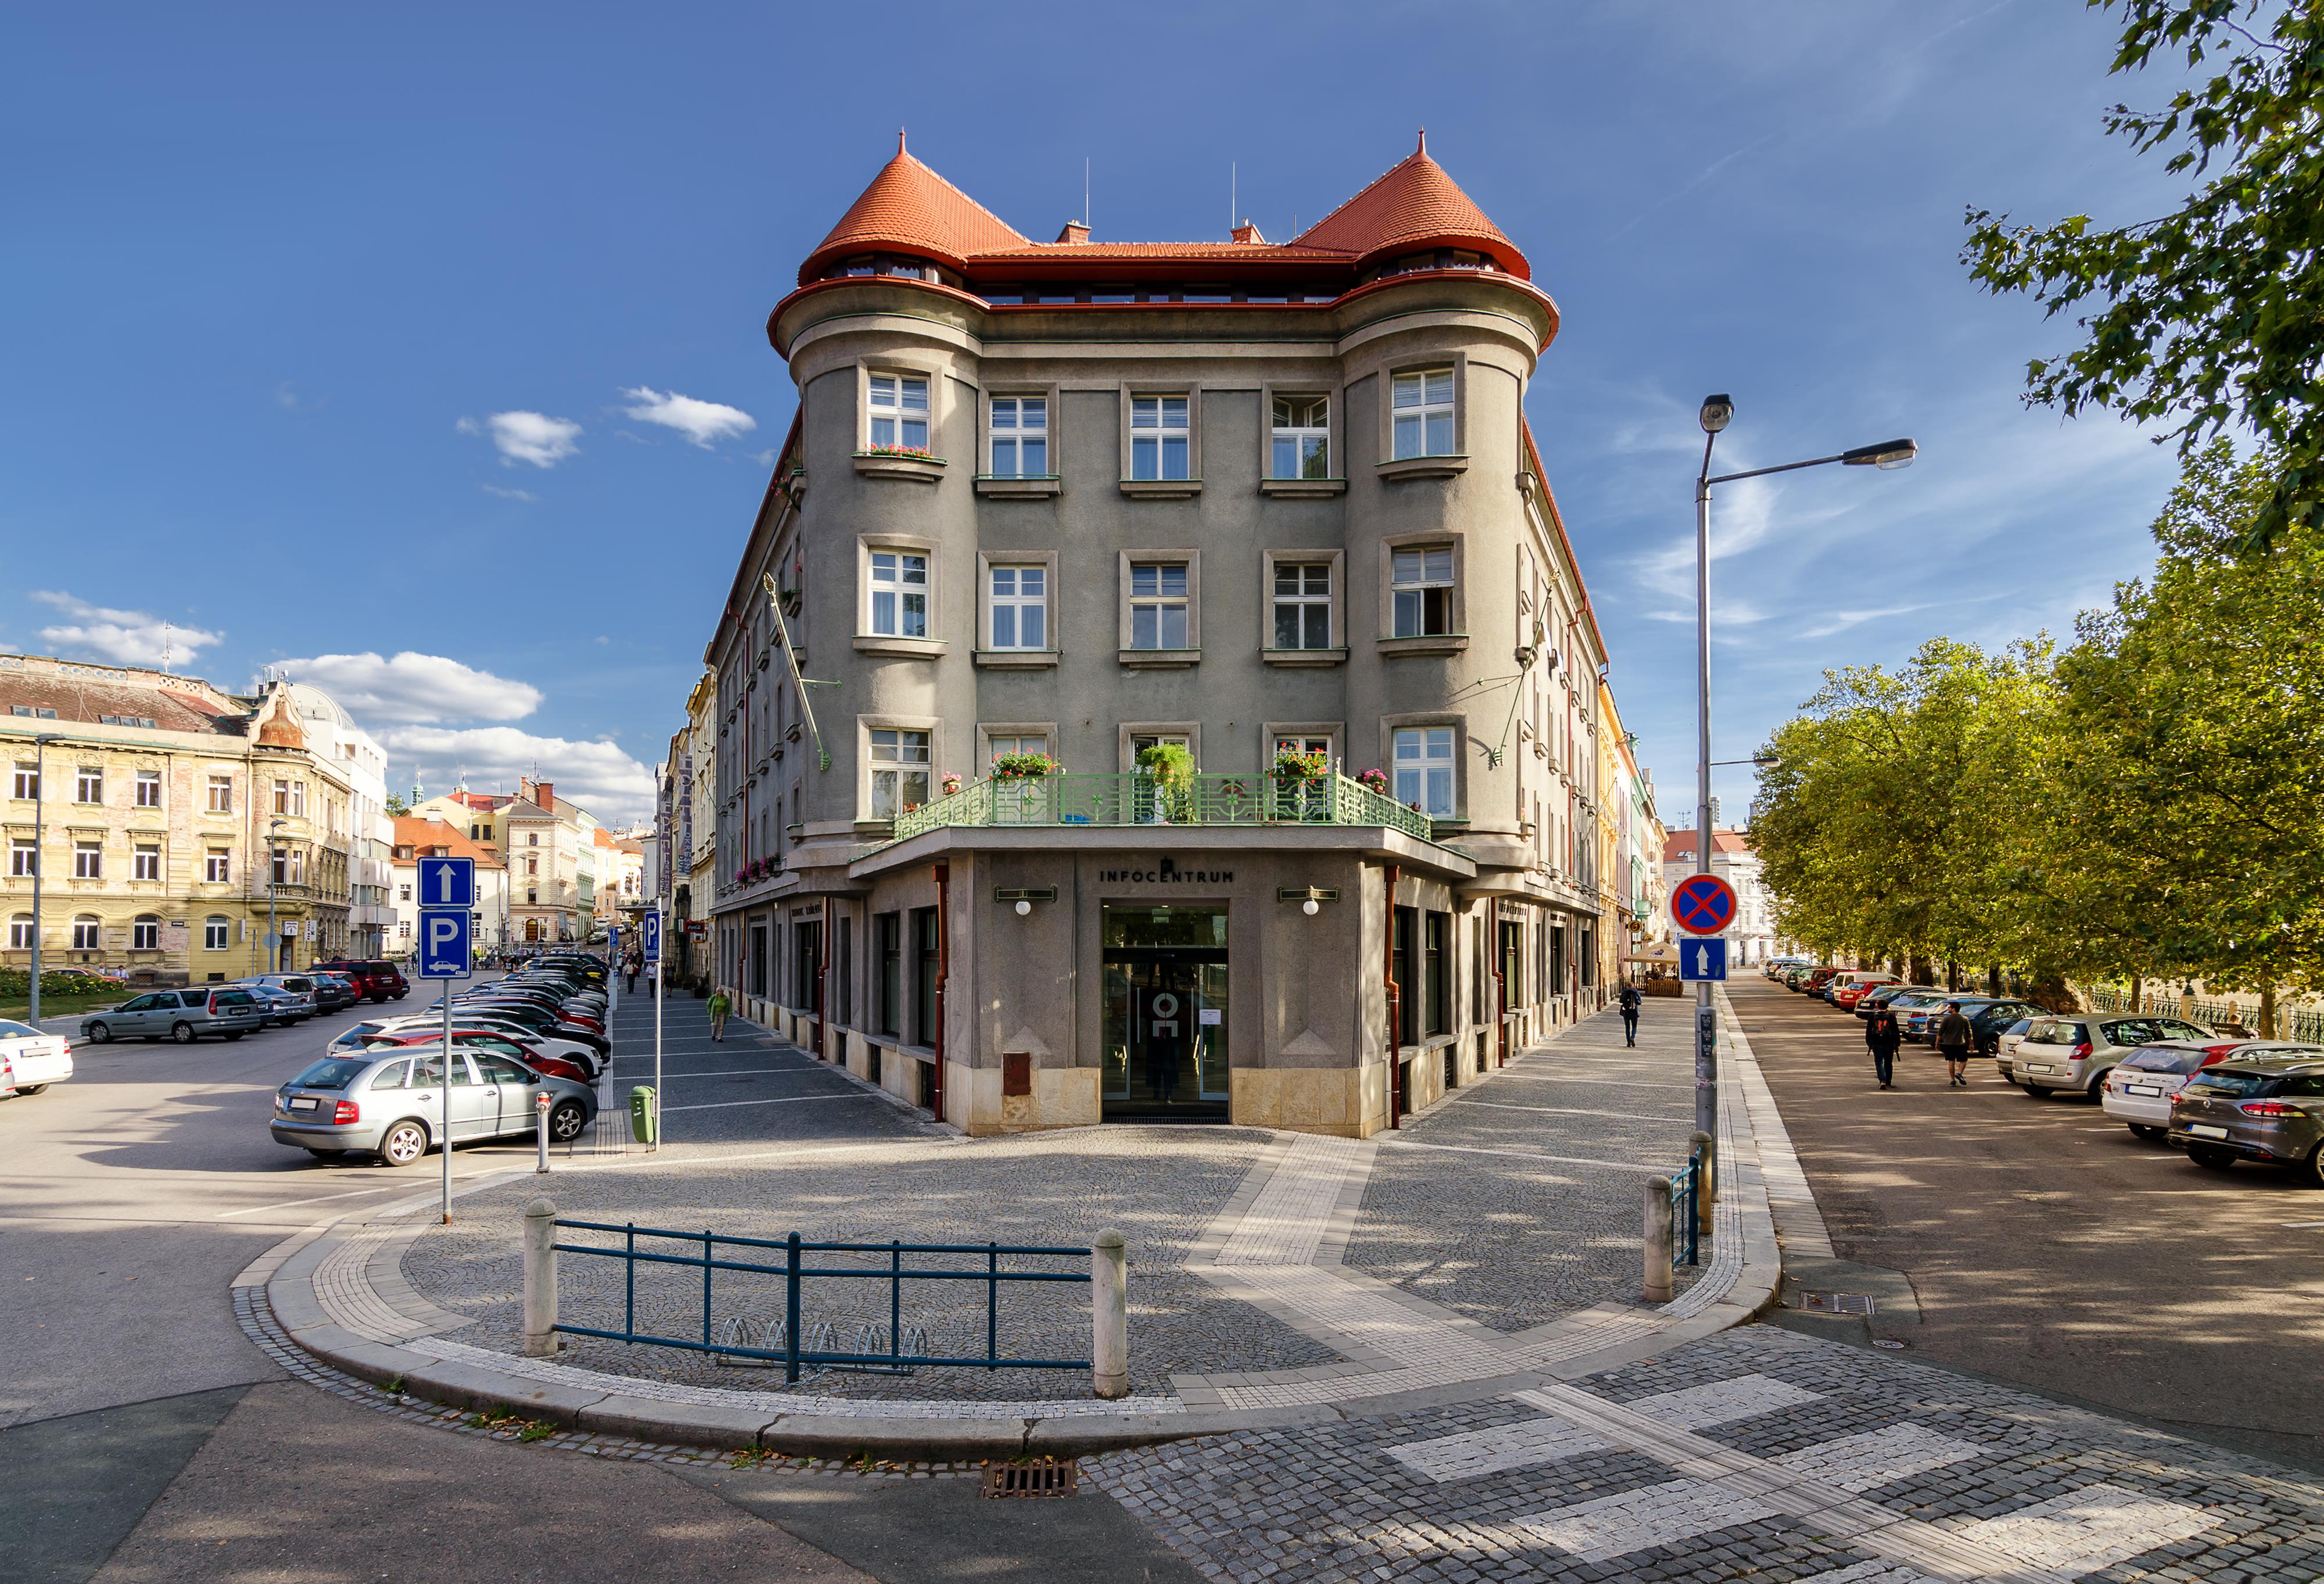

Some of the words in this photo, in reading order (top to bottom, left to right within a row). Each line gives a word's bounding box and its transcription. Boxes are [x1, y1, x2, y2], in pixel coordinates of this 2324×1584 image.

[1100, 870, 1233, 883] INFOCENTRUM
[430, 918, 458, 956] P
[648, 918, 657, 946] P
